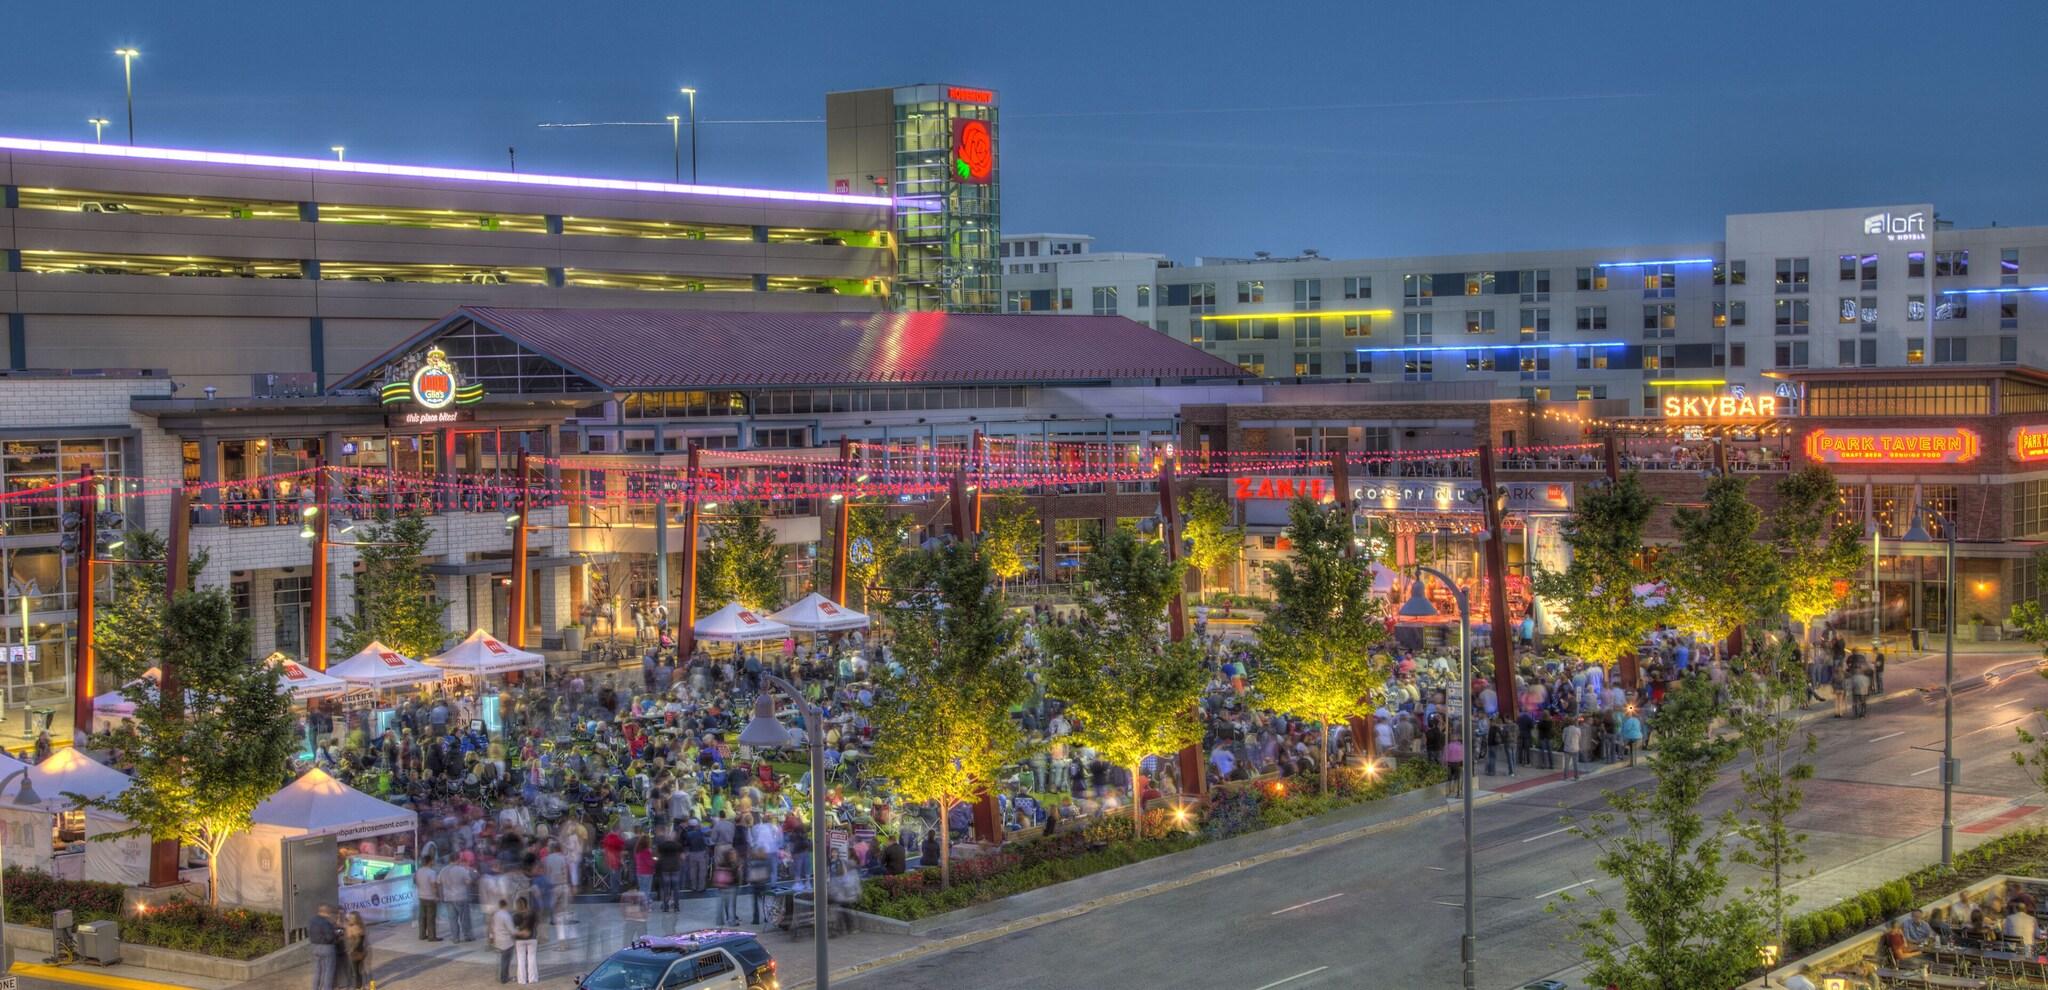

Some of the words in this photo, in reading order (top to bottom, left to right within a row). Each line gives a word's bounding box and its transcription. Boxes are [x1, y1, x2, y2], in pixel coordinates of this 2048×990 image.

[1665, 396, 1775, 416] SKYBAR
[1821, 437, 1875, 450] PARK
[1880, 437, 1962, 450] TAVERN
[1235, 477, 1337, 500] ZANIE
[381, 891, 413, 904] CHICAGO
[0, 980, 15, 989] NE
